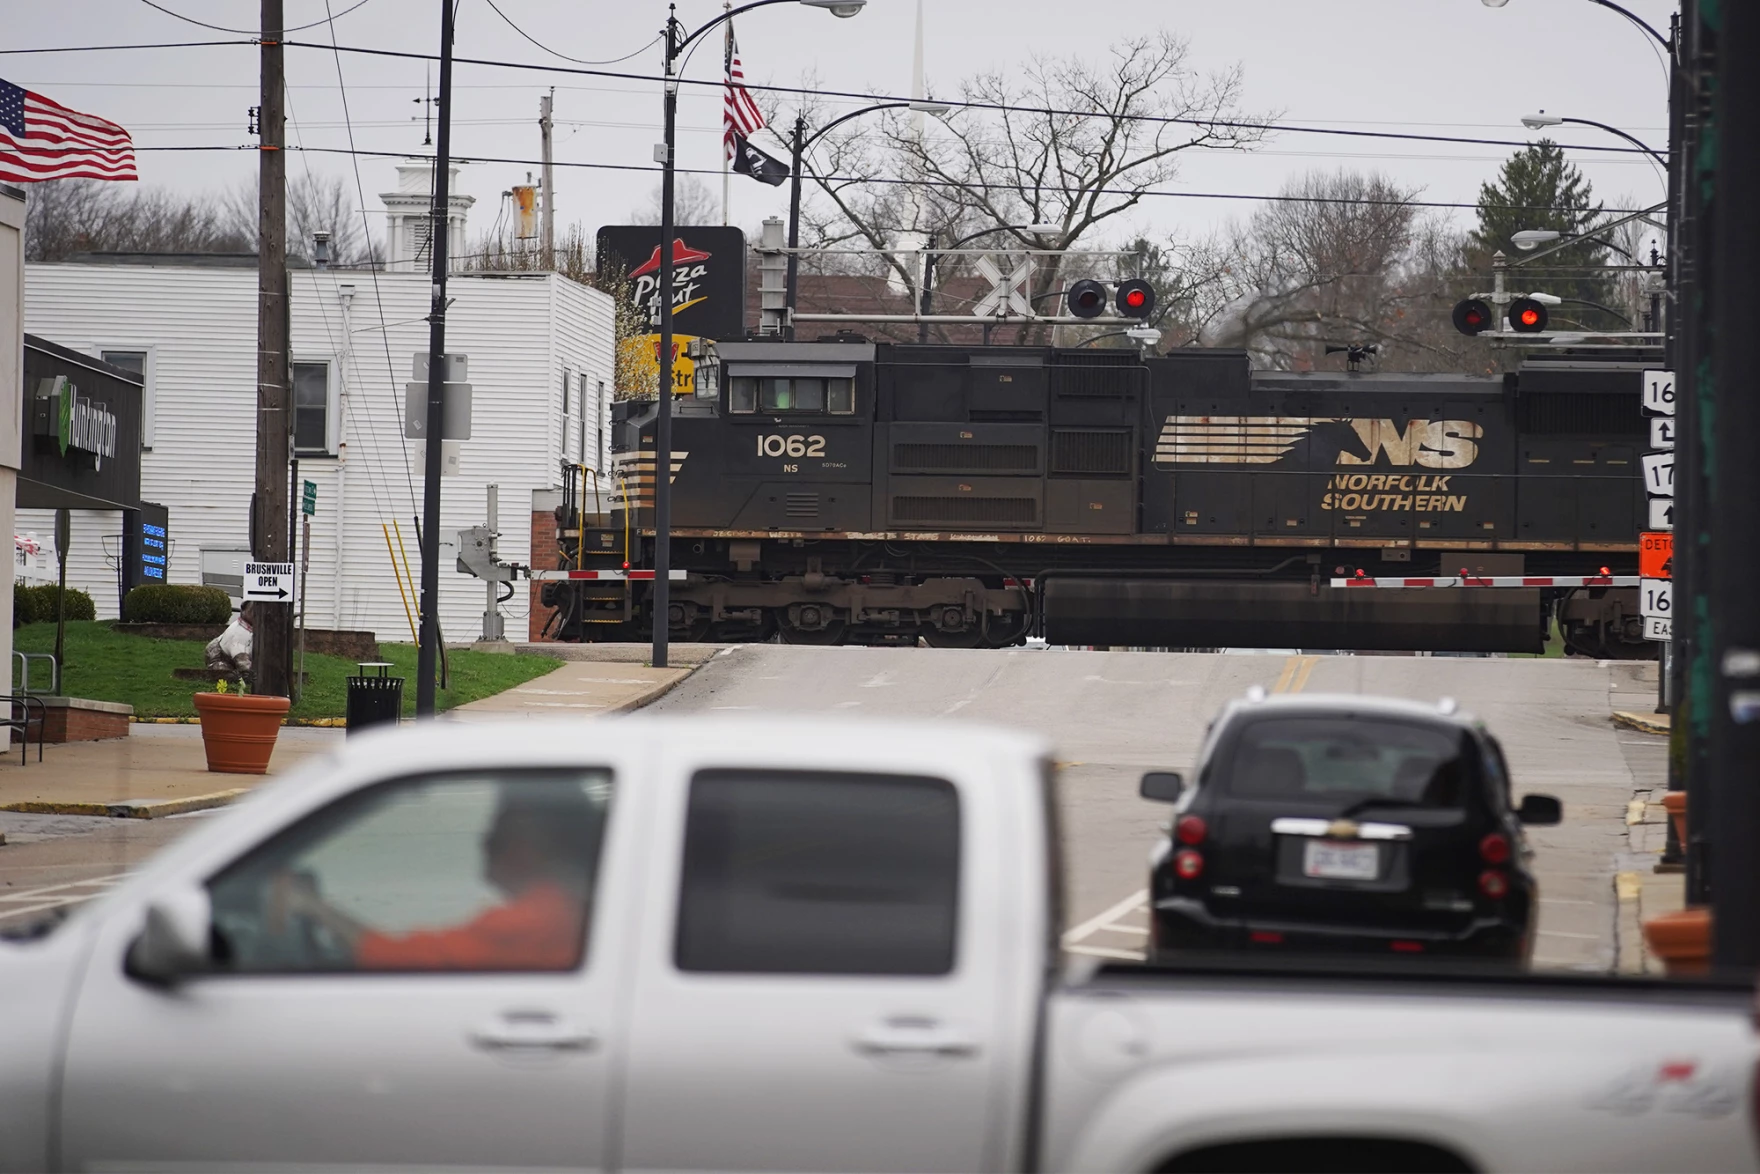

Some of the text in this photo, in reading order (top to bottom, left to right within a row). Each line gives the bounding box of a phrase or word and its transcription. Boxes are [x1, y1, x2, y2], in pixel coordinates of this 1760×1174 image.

[68, 383, 116, 472] Huntington
[757, 435, 826, 457] 1062
[1336, 419, 1484, 469] NS
[783, 464, 799, 473] NS
[1327, 475, 1452, 492] NORFOLK
[1321, 493, 1467, 512] SOUTHERN
[246, 563, 292, 575] BRUSHVILLE
[258, 576, 278, 587] OPEN
[1647, 590, 1671, 612] 16
